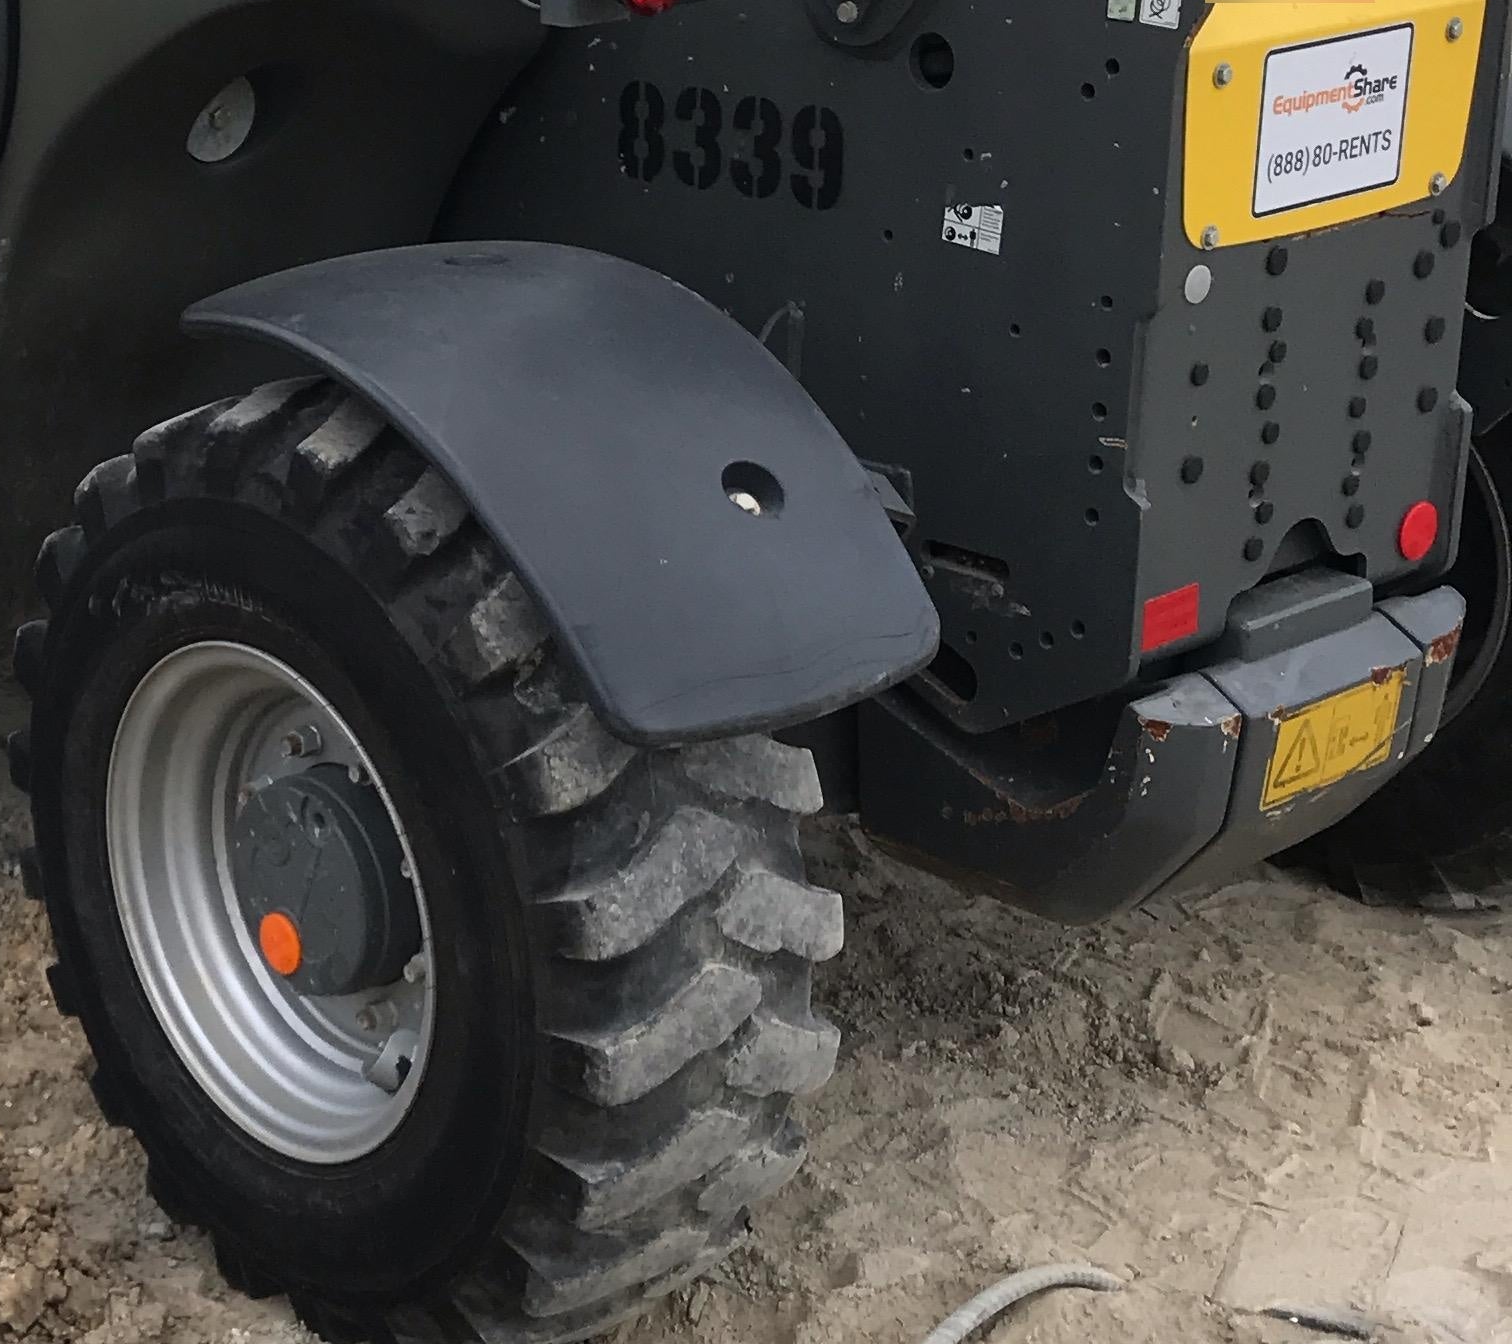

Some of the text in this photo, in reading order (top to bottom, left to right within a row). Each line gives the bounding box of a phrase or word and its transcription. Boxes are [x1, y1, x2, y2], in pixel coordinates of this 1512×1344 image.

[617, 80, 845, 211] 8339
[1267, 128, 1393, 184] (888) 80-RENTS
